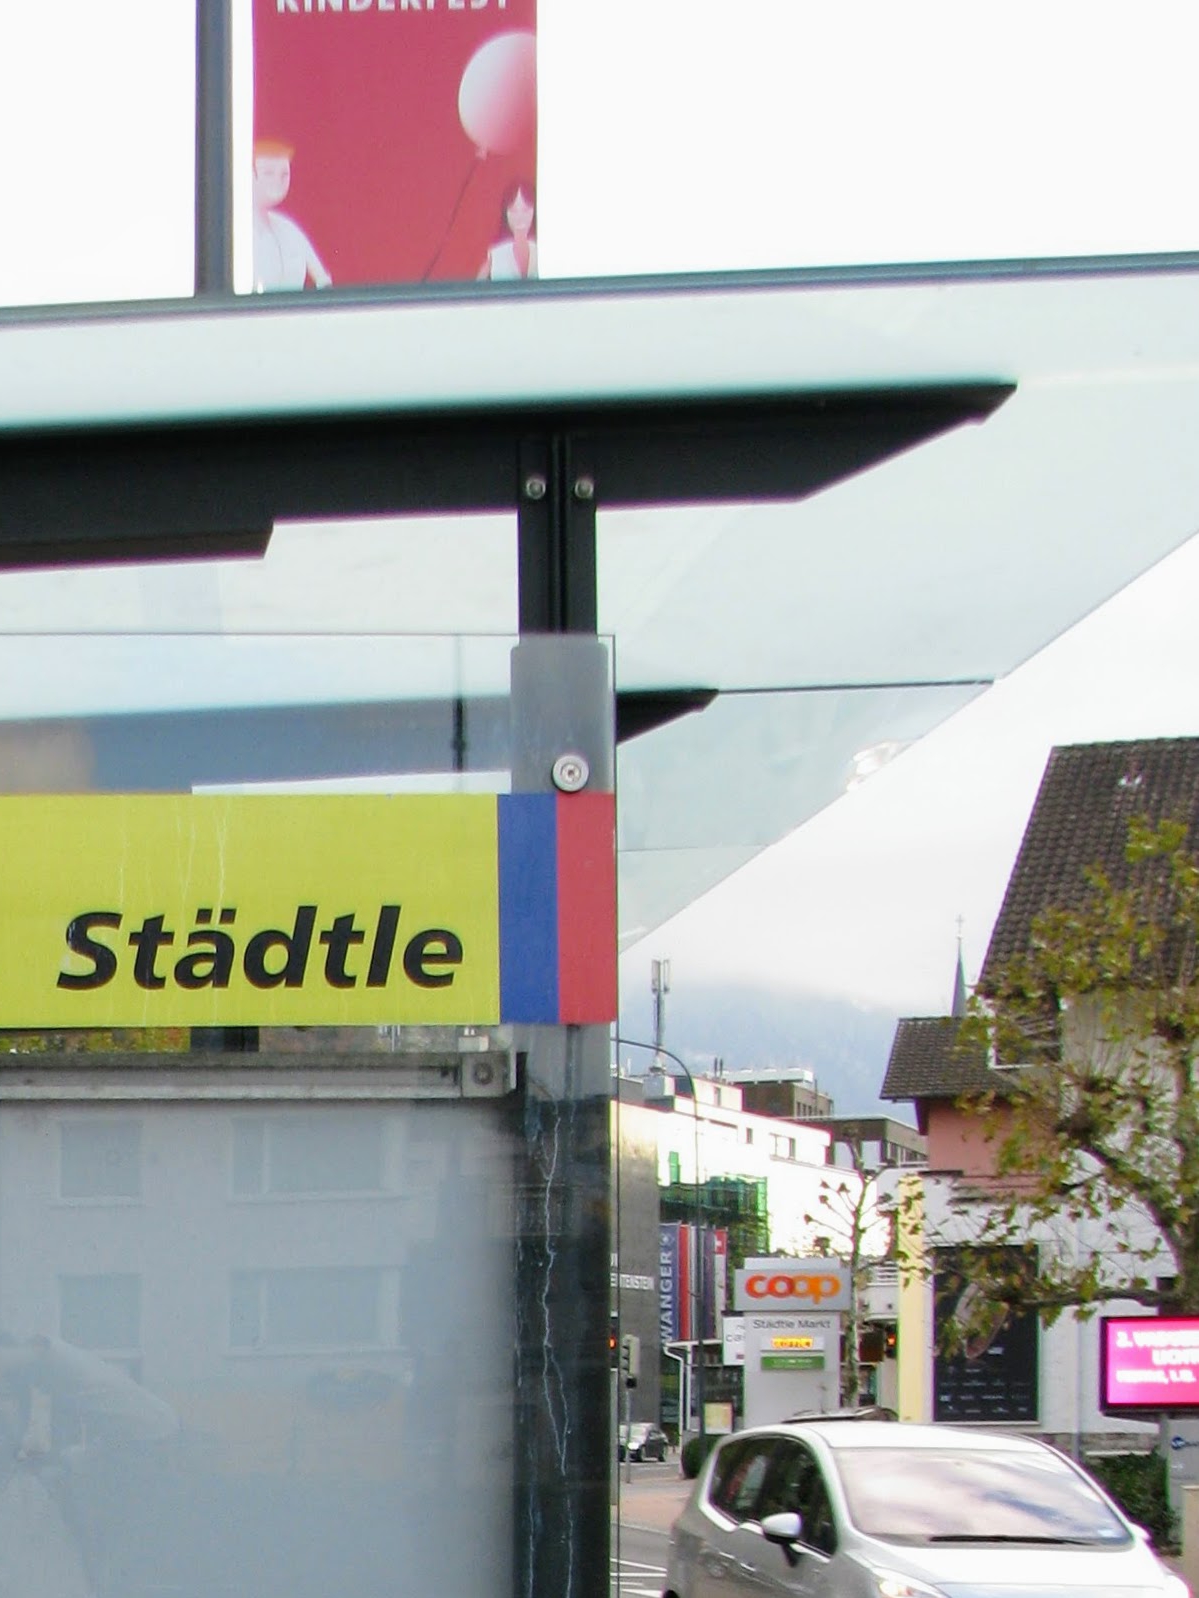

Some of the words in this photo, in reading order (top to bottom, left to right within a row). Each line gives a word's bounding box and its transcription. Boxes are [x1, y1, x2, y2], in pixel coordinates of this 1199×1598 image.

[56, 905, 464, 991] Städtle
[745, 1275, 840, 1304] coop
[798, 1319, 831, 1329] Markt
